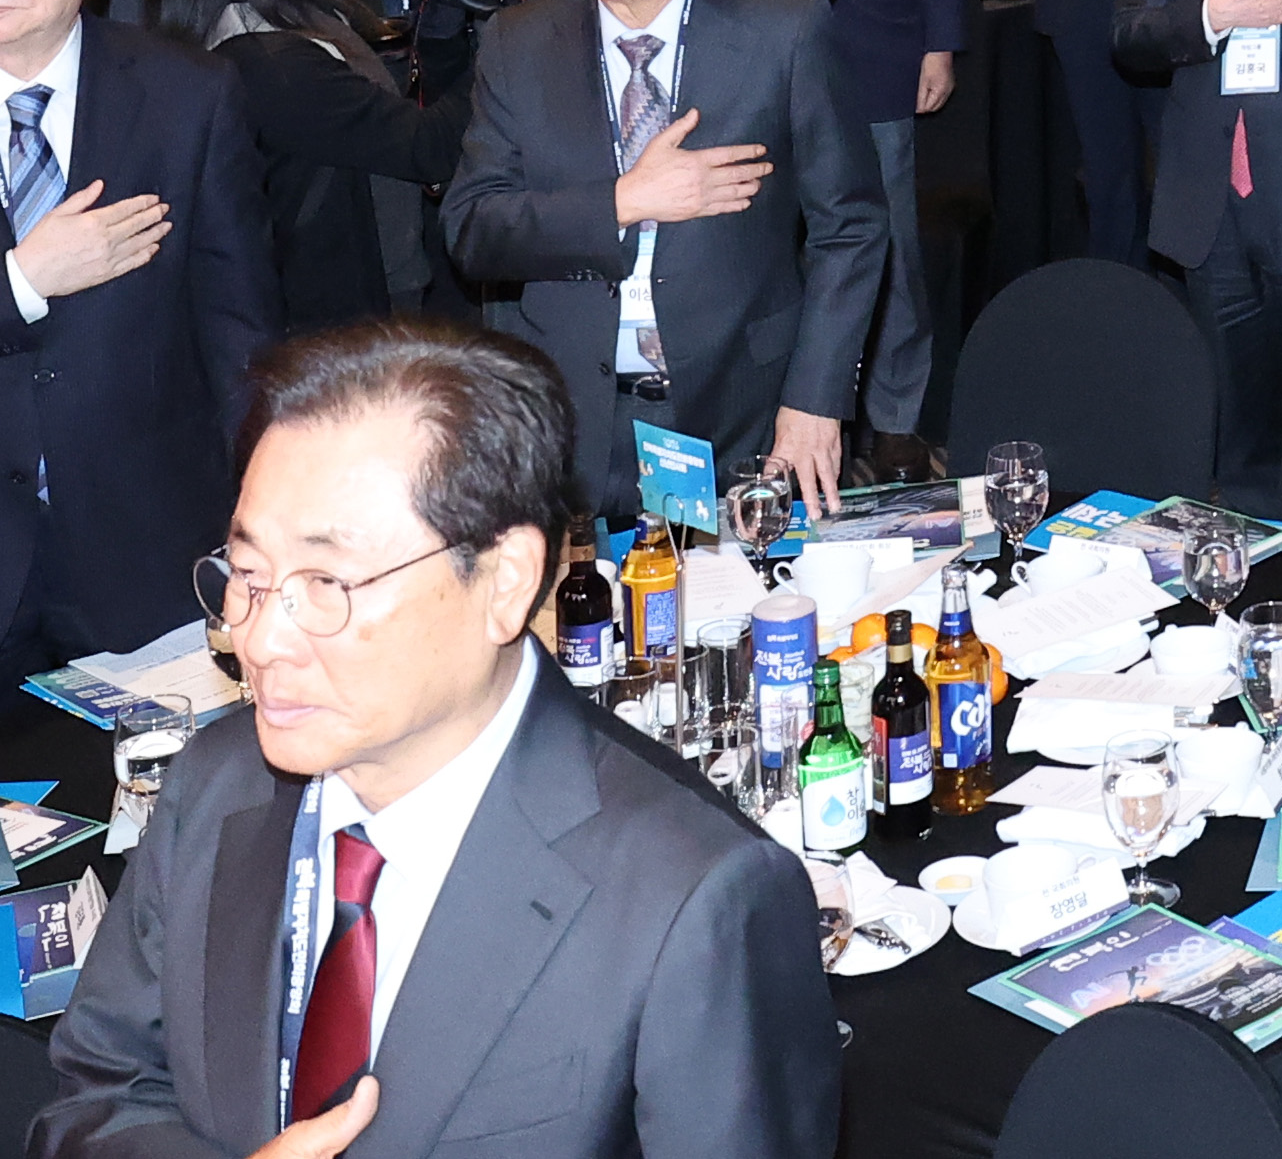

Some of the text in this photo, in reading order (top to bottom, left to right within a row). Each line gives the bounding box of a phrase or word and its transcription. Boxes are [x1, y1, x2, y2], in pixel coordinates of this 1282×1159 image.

[629, 287, 652, 301] 이상
[846, 786, 860, 806] 참
[1050, 891, 1088, 920] 장영달
[1050, 931, 1139, 972] 전북인
